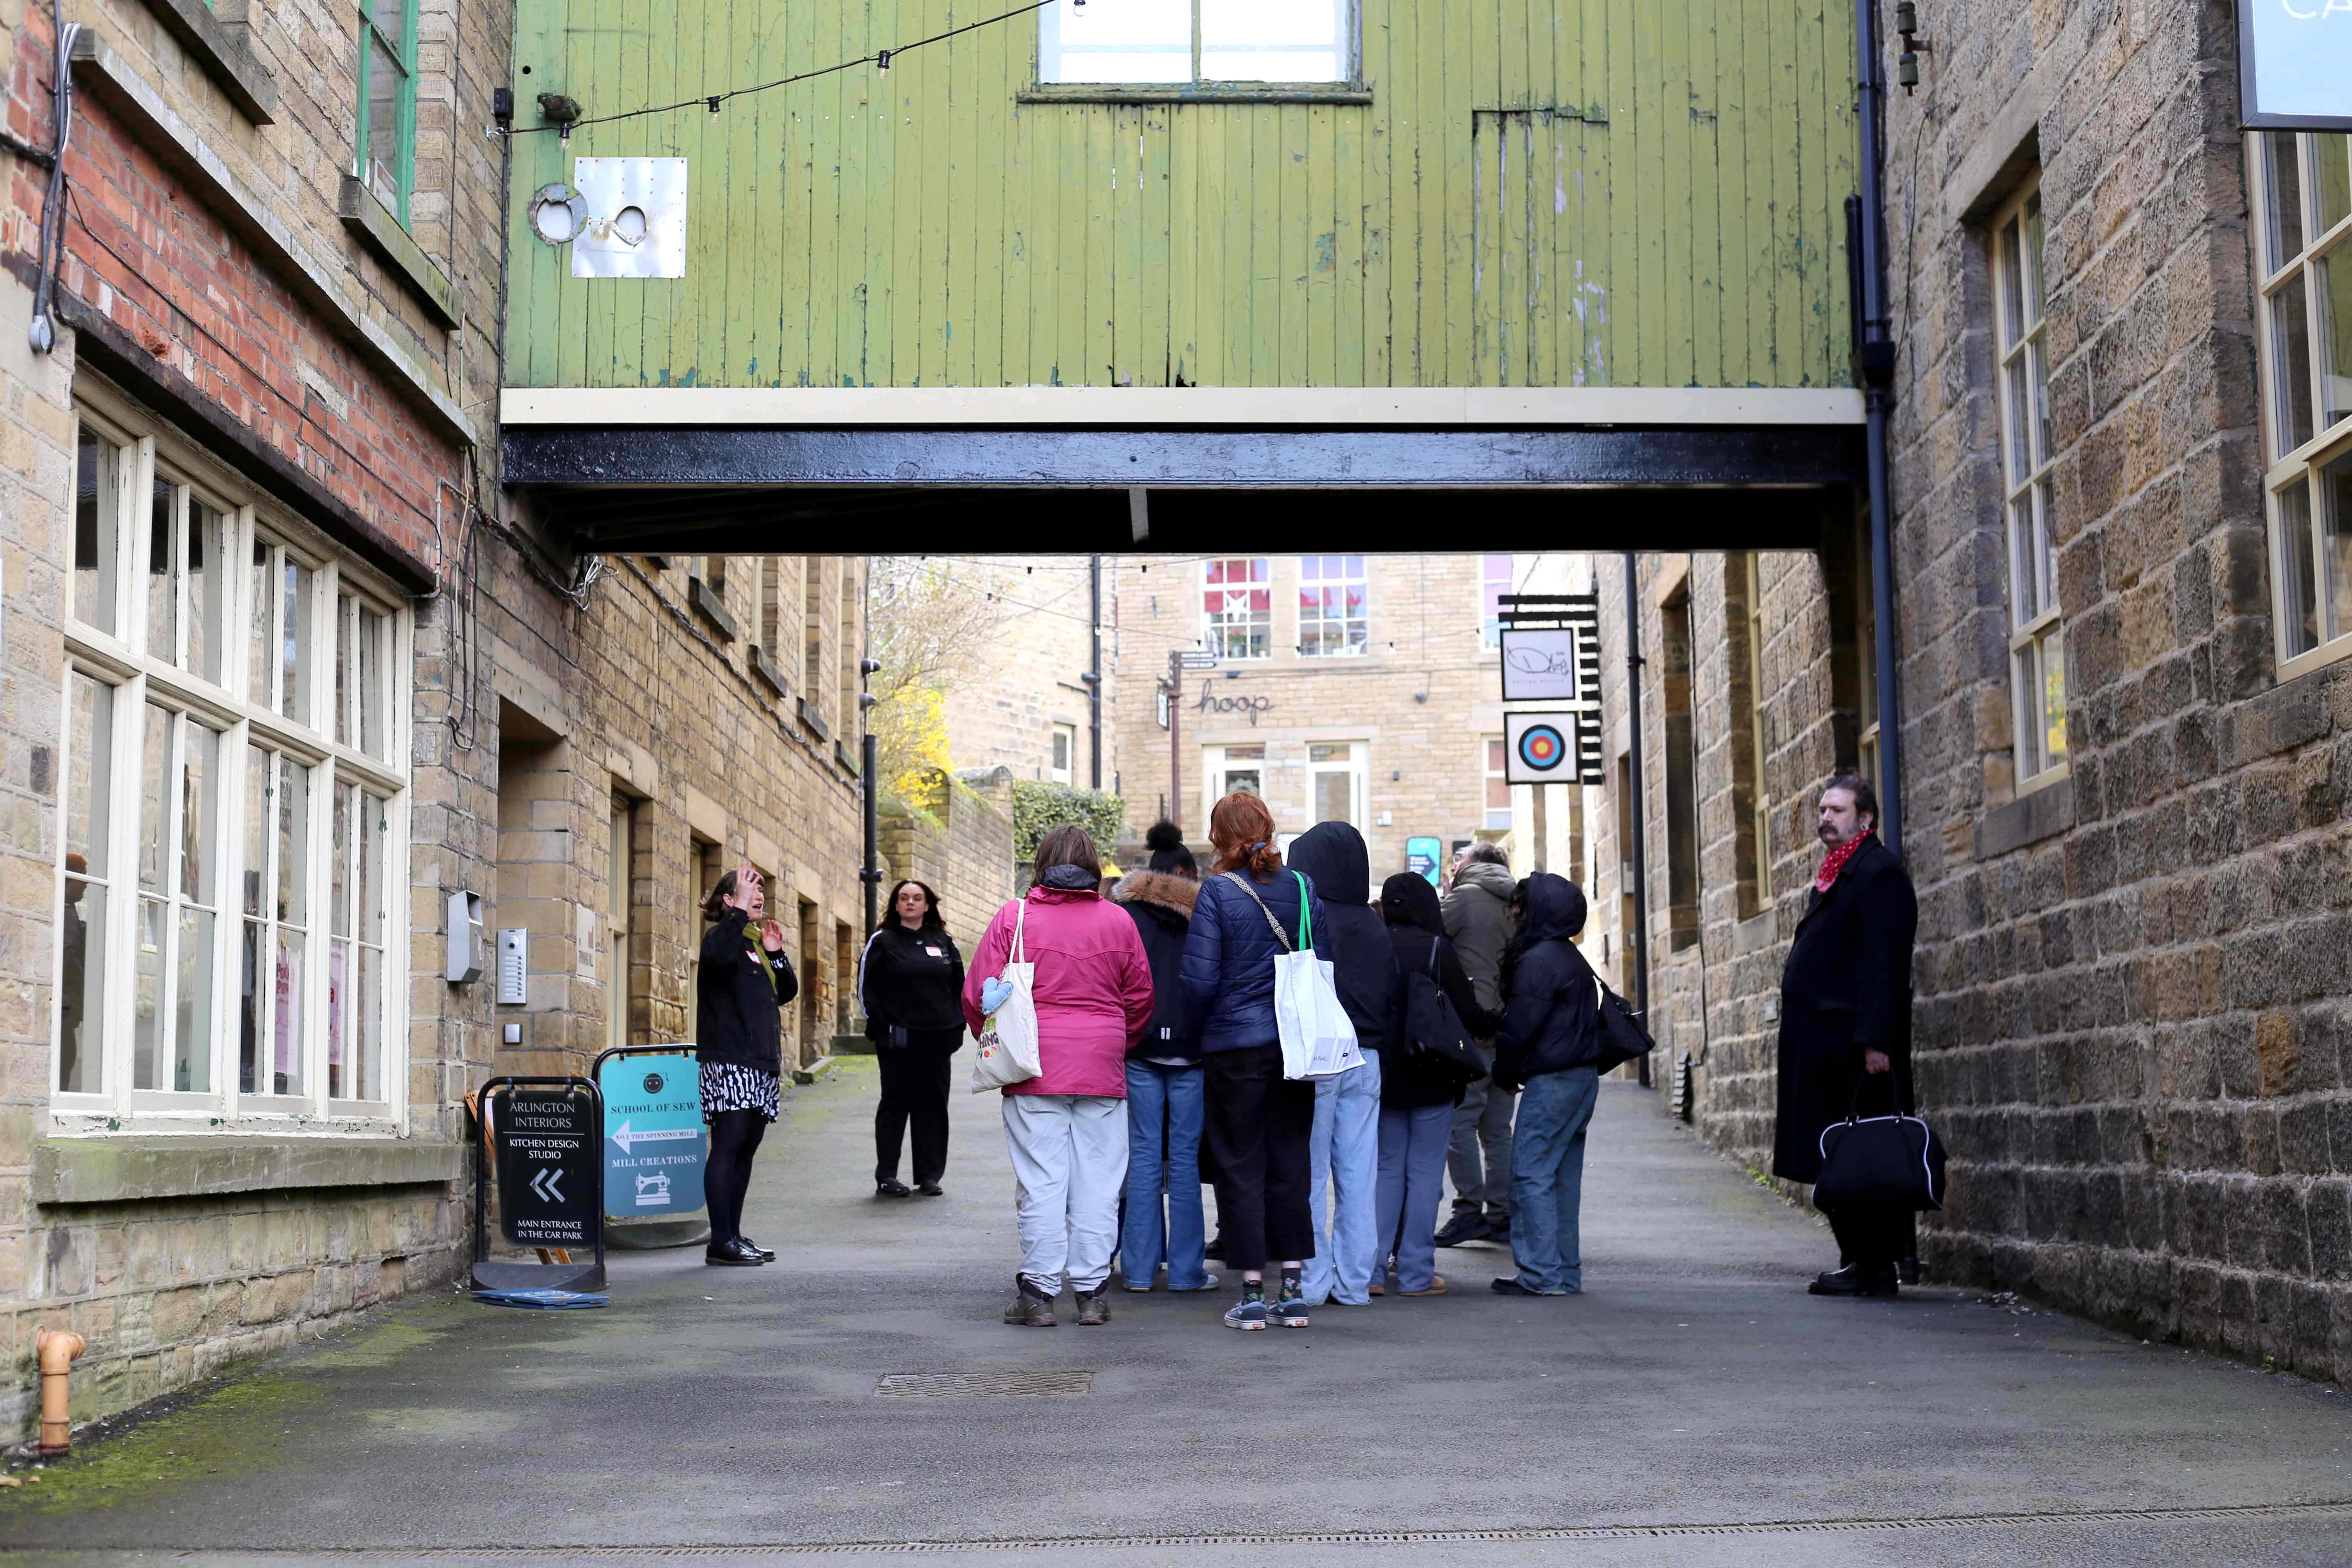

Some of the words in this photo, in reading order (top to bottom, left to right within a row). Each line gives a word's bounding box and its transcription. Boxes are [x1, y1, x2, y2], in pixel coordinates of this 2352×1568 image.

[1190, 679, 1276, 726] hoop
[510, 1102, 575, 1113] ARLINGTON
[611, 1104, 653, 1114] SCHOOL
[656, 1103, 670, 1112] OF
[673, 1102, 696, 1111] SEW
[515, 1117, 572, 1128] INTERIORS
[510, 1139, 545, 1148] KITCHEN
[548, 1140, 579, 1148] DESIGN
[528, 1151, 562, 1159] STUDIO
[612, 1158, 638, 1168] MILL
[639, 1155, 697, 1167] CREATIONS
[540, 1220, 582, 1229] ENTRANCE
[562, 1232, 583, 1240] PARK
